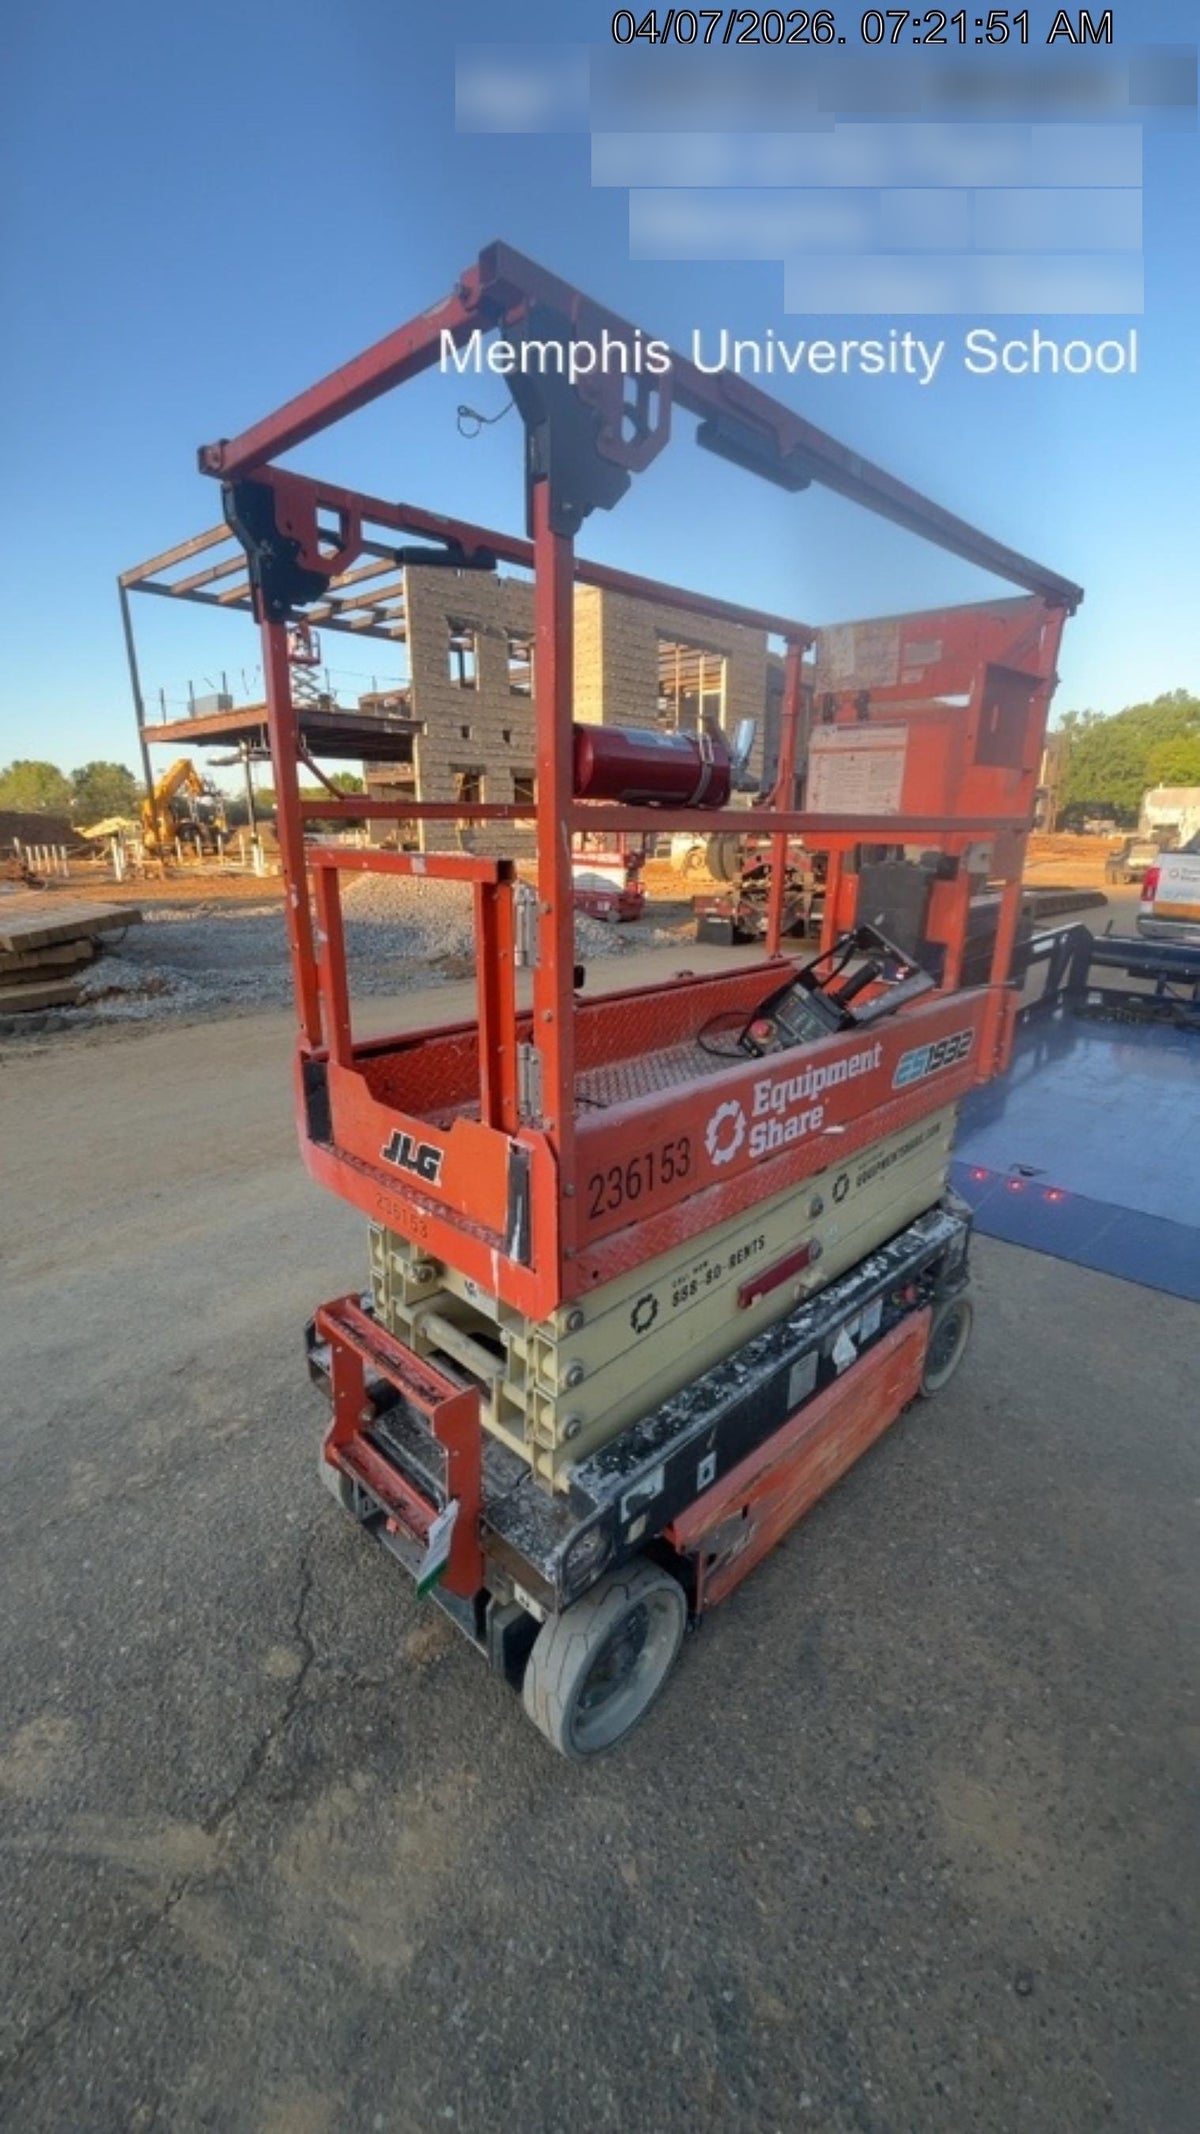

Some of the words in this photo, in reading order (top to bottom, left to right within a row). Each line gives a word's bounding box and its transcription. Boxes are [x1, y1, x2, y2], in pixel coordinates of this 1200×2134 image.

[752, 1041, 884, 1117] Equipment
[380, 1130, 443, 1186] JLG
[748, 1105, 825, 1158] Share
[588, 1137, 691, 1220] 236153
